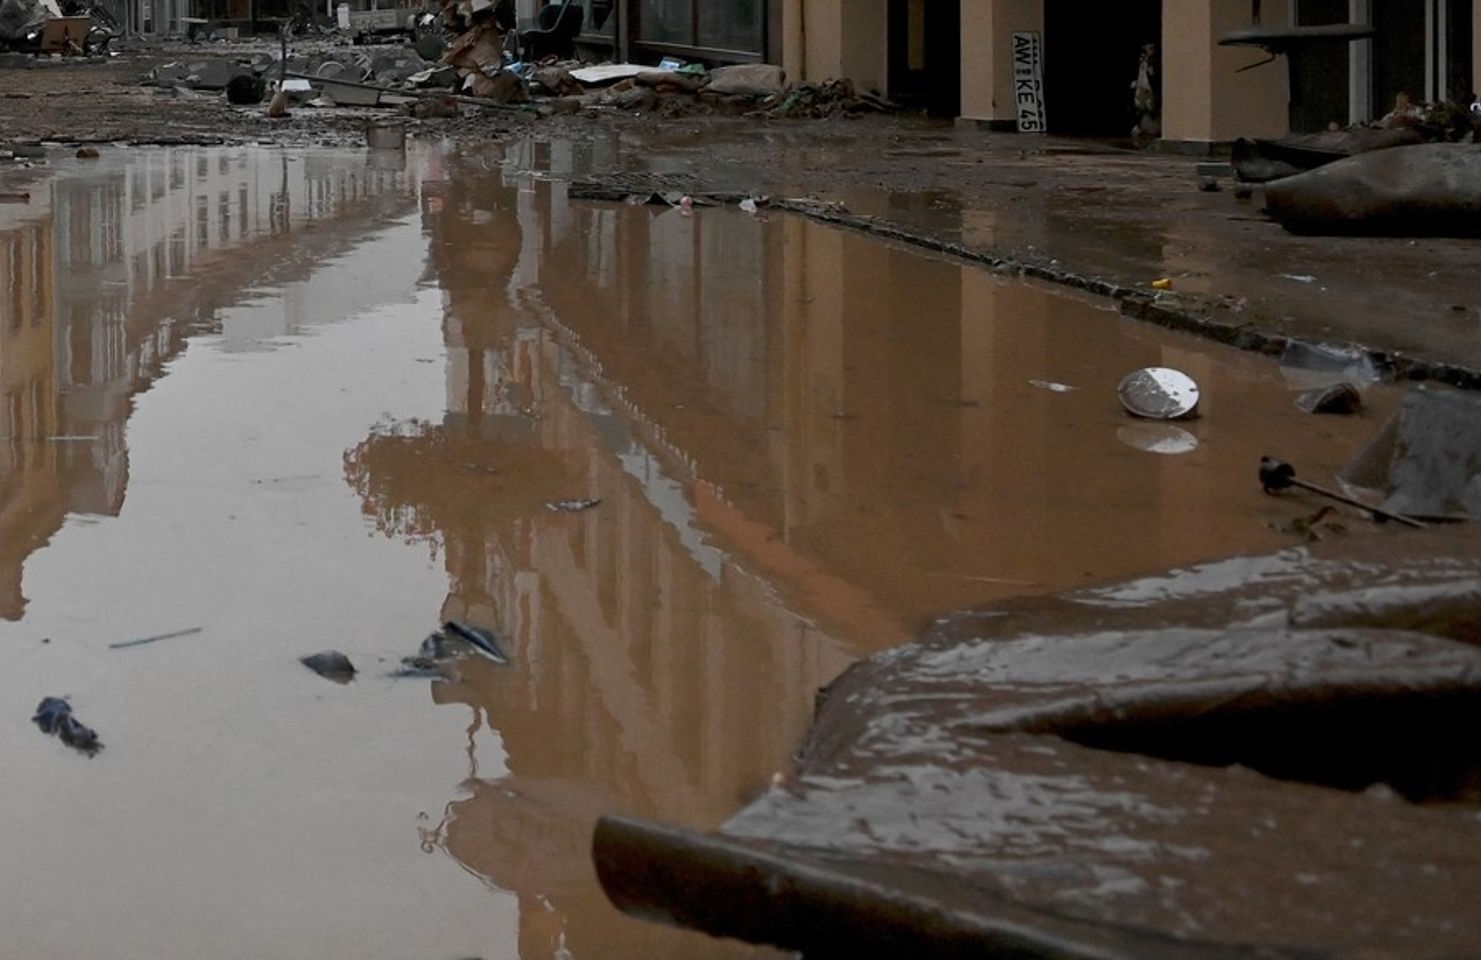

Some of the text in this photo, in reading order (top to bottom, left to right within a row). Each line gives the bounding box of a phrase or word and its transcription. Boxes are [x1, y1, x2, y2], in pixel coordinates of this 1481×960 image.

[1014, 35, 1038, 130] AW KE 45
